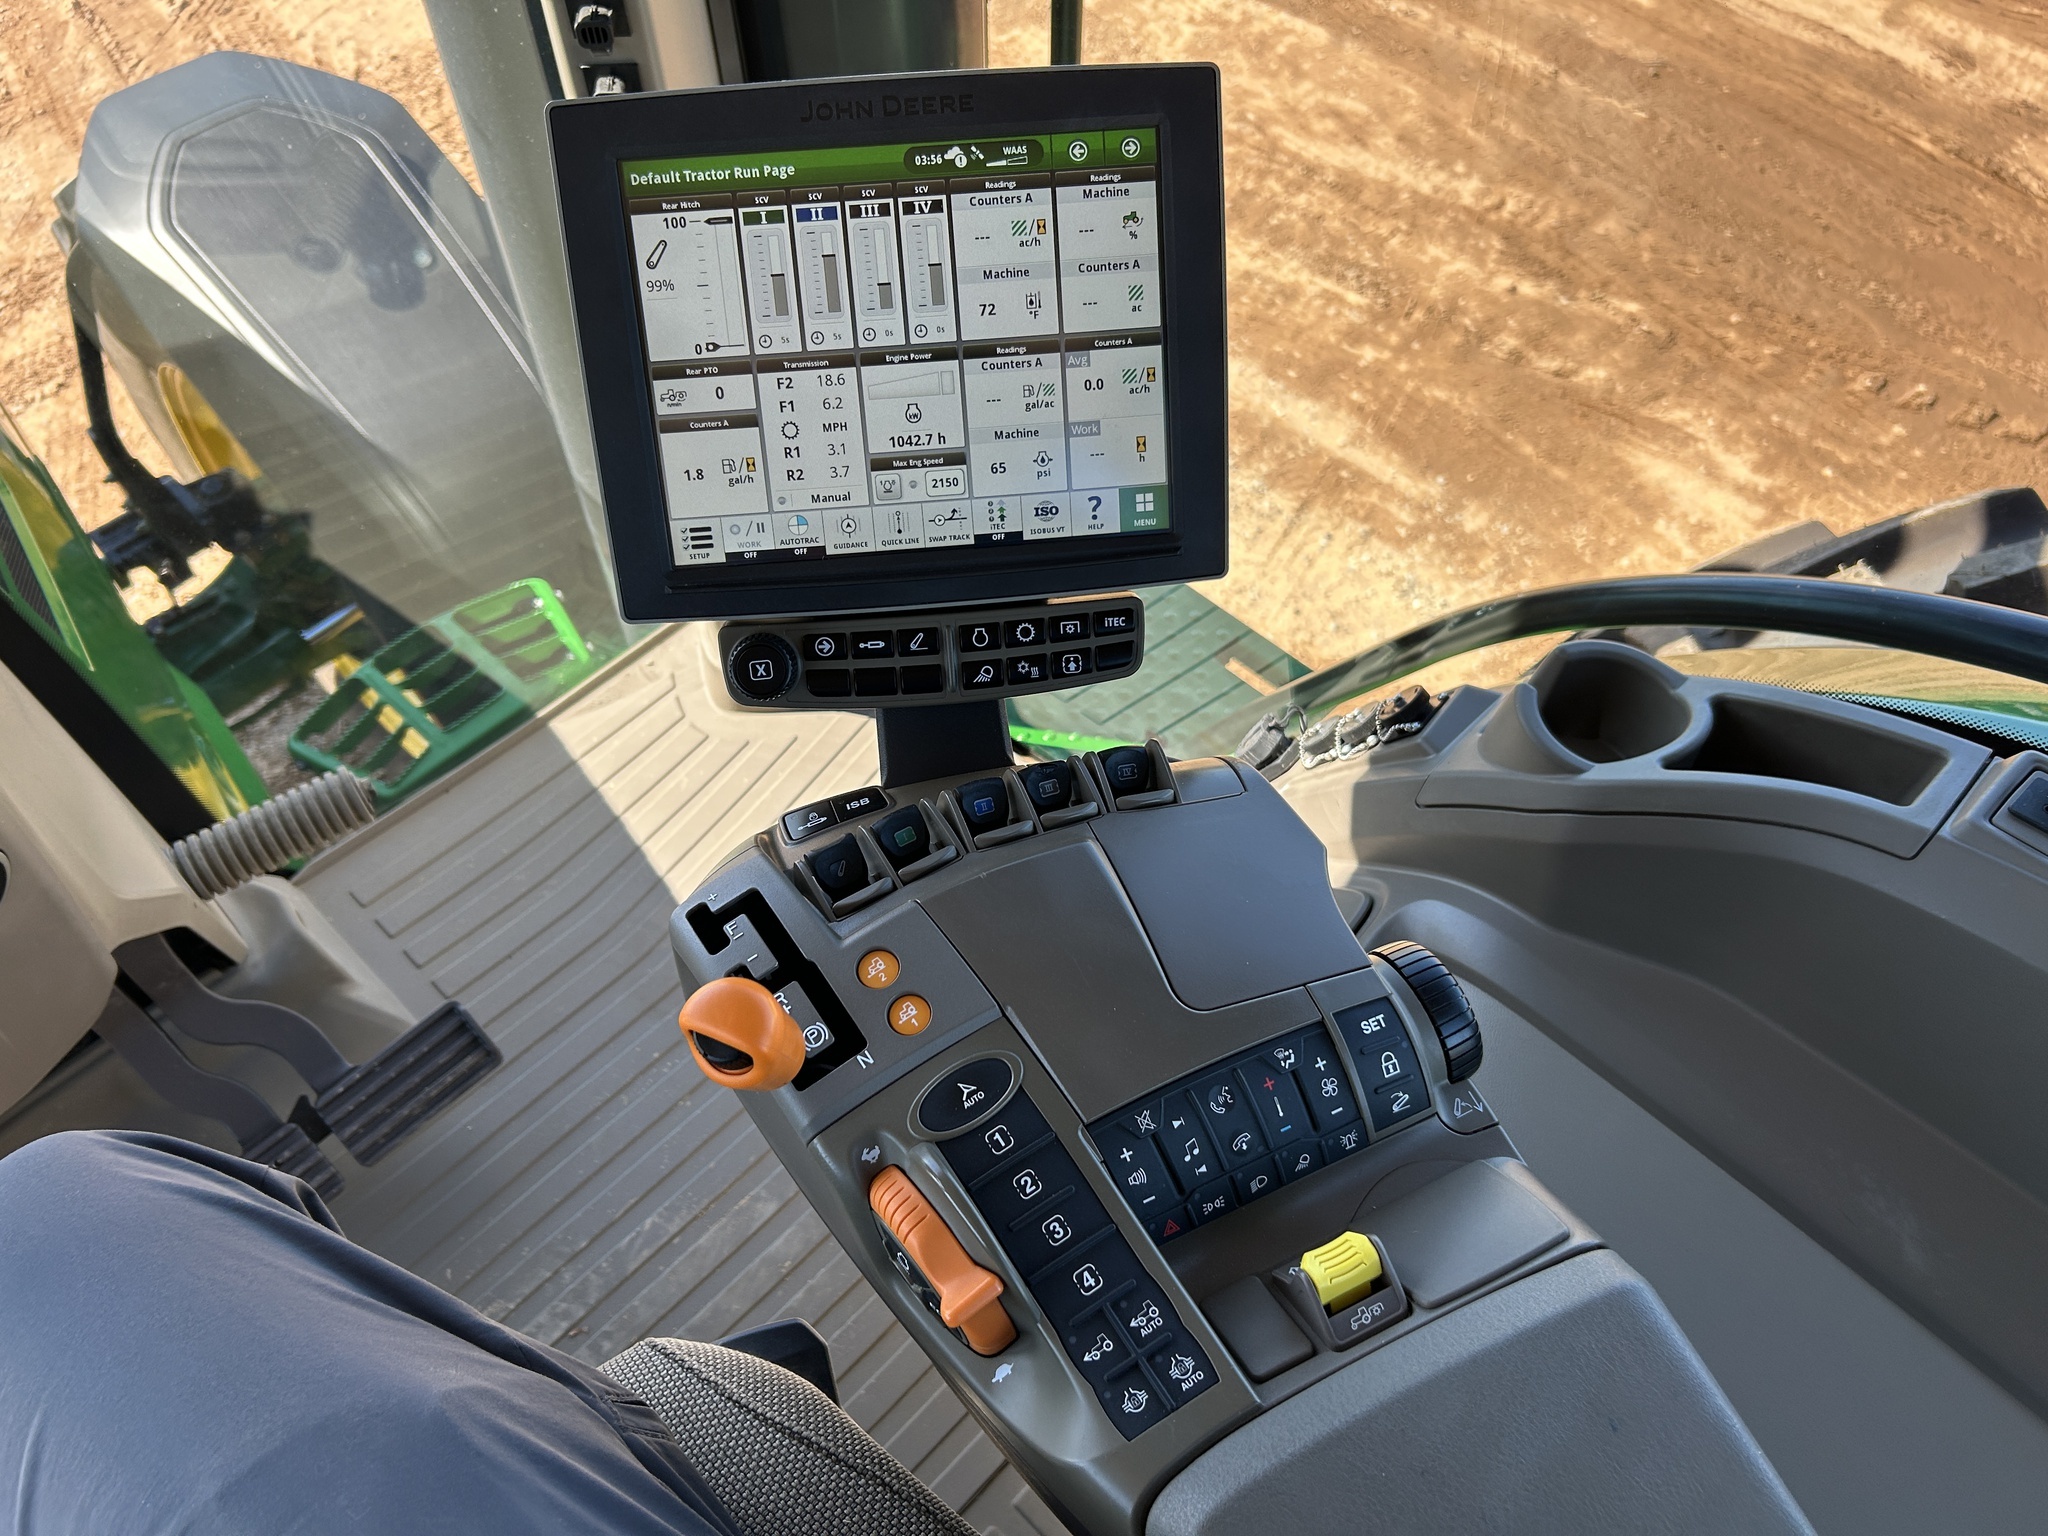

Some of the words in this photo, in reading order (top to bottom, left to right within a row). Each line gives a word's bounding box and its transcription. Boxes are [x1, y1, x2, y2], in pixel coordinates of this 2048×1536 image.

[1003, 145, 1028, 155] WAAS
[914, 154, 943, 166] 03:56
[630, 170, 681, 186] Default
[683, 166, 730, 182] Tractor
[734, 167, 760, 179] Run
[764, 164, 795, 180] Page
[1090, 173, 1121, 183] Readings
[914, 186, 928, 194] SCV
[985, 180, 1017, 189] Readings
[808, 192, 823, 200] SCV
[861, 189, 876, 197] SCV
[1082, 186, 1130, 199] Machine
[662, 202, 679, 210] Rear
[680, 200, 701, 209] Hitch
[755, 196, 769, 204] SCV
[969, 194, 1022, 207] Counters
[1024, 192, 1033, 203] A
[860, 204, 880, 217] III
[913, 201, 933, 214] IV
[760, 212, 767, 224] I
[811, 208, 825, 220] II
[662, 216, 687, 230] 100
[1129, 230, 1138, 240] %
[1019, 236, 1041, 248] ac/h
[1078, 260, 1129, 273] Counters
[1130, 259, 1141, 270] A
[983, 267, 1030, 280] Machine
[646, 279, 675, 292] 99%
[979, 303, 997, 317] 72
[1131, 304, 1142, 313] ac
[1029, 310, 1040, 320] °F
[885, 328, 894, 337] 0s
[937, 326, 945, 334] 0s
[781, 335, 790, 344] 5s
[833, 332, 842, 341] 5s
[1095, 339, 1126, 347] Counters
[695, 344, 702, 355] 0
[996, 346, 1027, 355] Readings
[886, 354, 909, 363] Engine
[910, 352, 932, 360] Power
[1067, 355, 1088, 367] Avg
[783, 359, 829, 369] Transmission
[981, 359, 1032, 371] Counters
[1034, 357, 1043, 367] A
[686, 368, 701, 376] Rear
[776, 377, 794, 390] F2
[817, 373, 846, 387] 18.6
[1084, 379, 1104, 391] 0.0
[716, 386, 724, 400] 0
[1129, 384, 1150, 395] ac/h
[779, 400, 795, 413] F1
[822, 397, 844, 410] 6.2
[1025, 400, 1055, 413] gal/ac
[690, 421, 722, 429] Counters
[822, 422, 848, 433] MPH
[1071, 424, 1099, 435] Work
[889, 434, 933, 448] 1042.7
[938, 432, 946, 444] h
[994, 428, 1040, 440] Machine
[784, 446, 801, 459] R1
[827, 443, 847, 455] 3.1
[909, 459, 922, 467] Eng
[923, 457, 944, 466] Speed
[1139, 454, 1145, 462] h
[786, 469, 805, 481] R2
[830, 466, 850, 478] 3.7
[990, 462, 1007, 475] 65
[1037, 469, 1051, 480] psi
[684, 469, 705, 481] 1.8
[728, 475, 754, 487] gal/h
[931, 477, 959, 488] 2150
[811, 492, 851, 504] Manual
[1033, 505, 1060, 517] ISO
[1088, 523, 1104, 531] HELP
[1134, 518, 1156, 527] MENU
[992, 533, 1005, 541] OFF
[1030, 527, 1055, 535] ISOBUS
[780, 536, 820, 546] AUTOTRAC
[881, 538, 903, 547] QUICK
[905, 537, 920, 545] LINE
[928, 535, 948, 543] SWAP
[948, 533, 971, 542] TRACK
[738, 540, 762, 549] WORK
[833, 541, 869, 550] GUIDANCE
[794, 548, 808, 556] OFF
[1104, 616, 1126, 628] iTEC
[755, 664, 767, 677] X
[846, 797, 870, 811] ISB
[878, 972, 887, 982] 2
[911, 1017, 918, 1027] 1
[1361, 1014, 1386, 1035] SET
[807, 1028, 818, 1044] P
[856, 1050, 875, 1069] N
[963, 1091, 985, 1109] AUTO
[993, 1132, 1005, 1147] 1
[1021, 1177, 1034, 1192] 2
[1050, 1222, 1063, 1239] 3
[1082, 1271, 1095, 1287] 4
[1140, 1316, 1163, 1337] AUTO
[1181, 1371, 1204, 1392] AUTO
